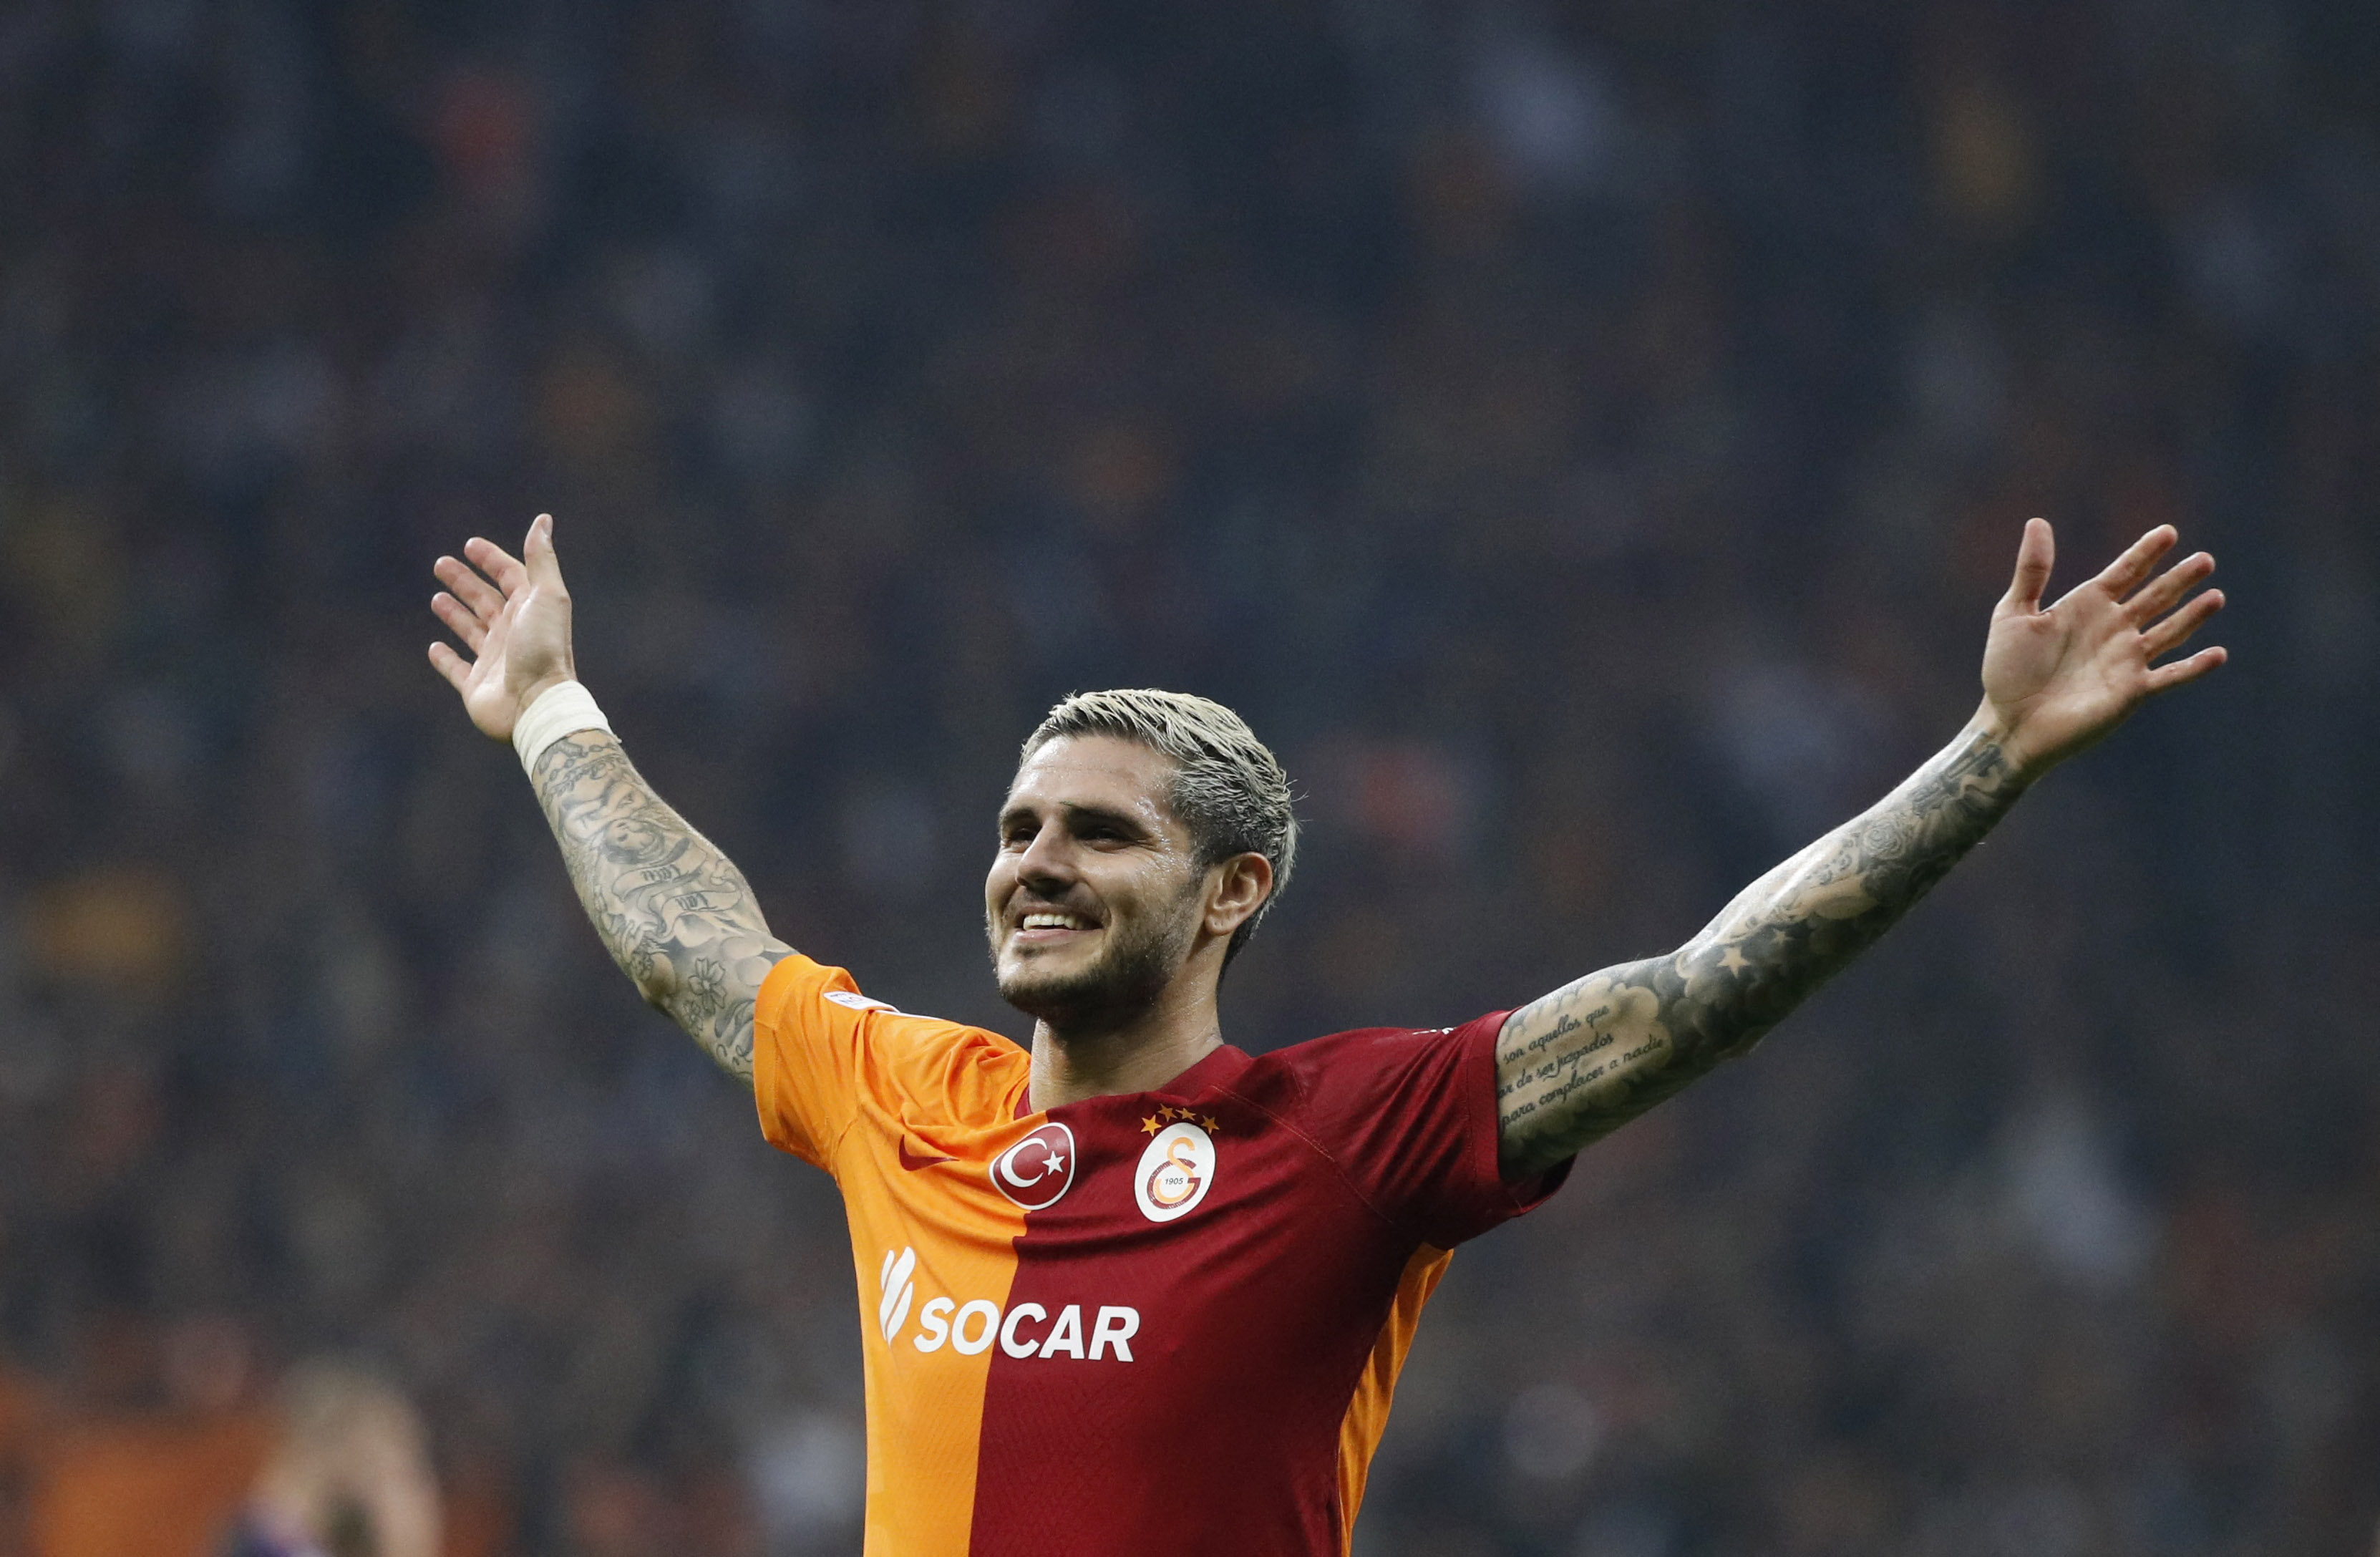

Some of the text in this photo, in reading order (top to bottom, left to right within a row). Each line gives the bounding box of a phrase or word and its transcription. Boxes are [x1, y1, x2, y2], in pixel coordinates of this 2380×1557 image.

[1504, 1005, 1609, 1065] son aquellos que
[1543, 1032, 1614, 1082] juzgados
[1516, 1069, 1533, 1090] de
[1537, 1064, 1555, 1078] ser
[1539, 1066, 1604, 1104] complacer
[1609, 1058, 1618, 1070] a
[1623, 1033, 1663, 1064] nadie
[913, 1296, 1140, 1362] SOCAR
